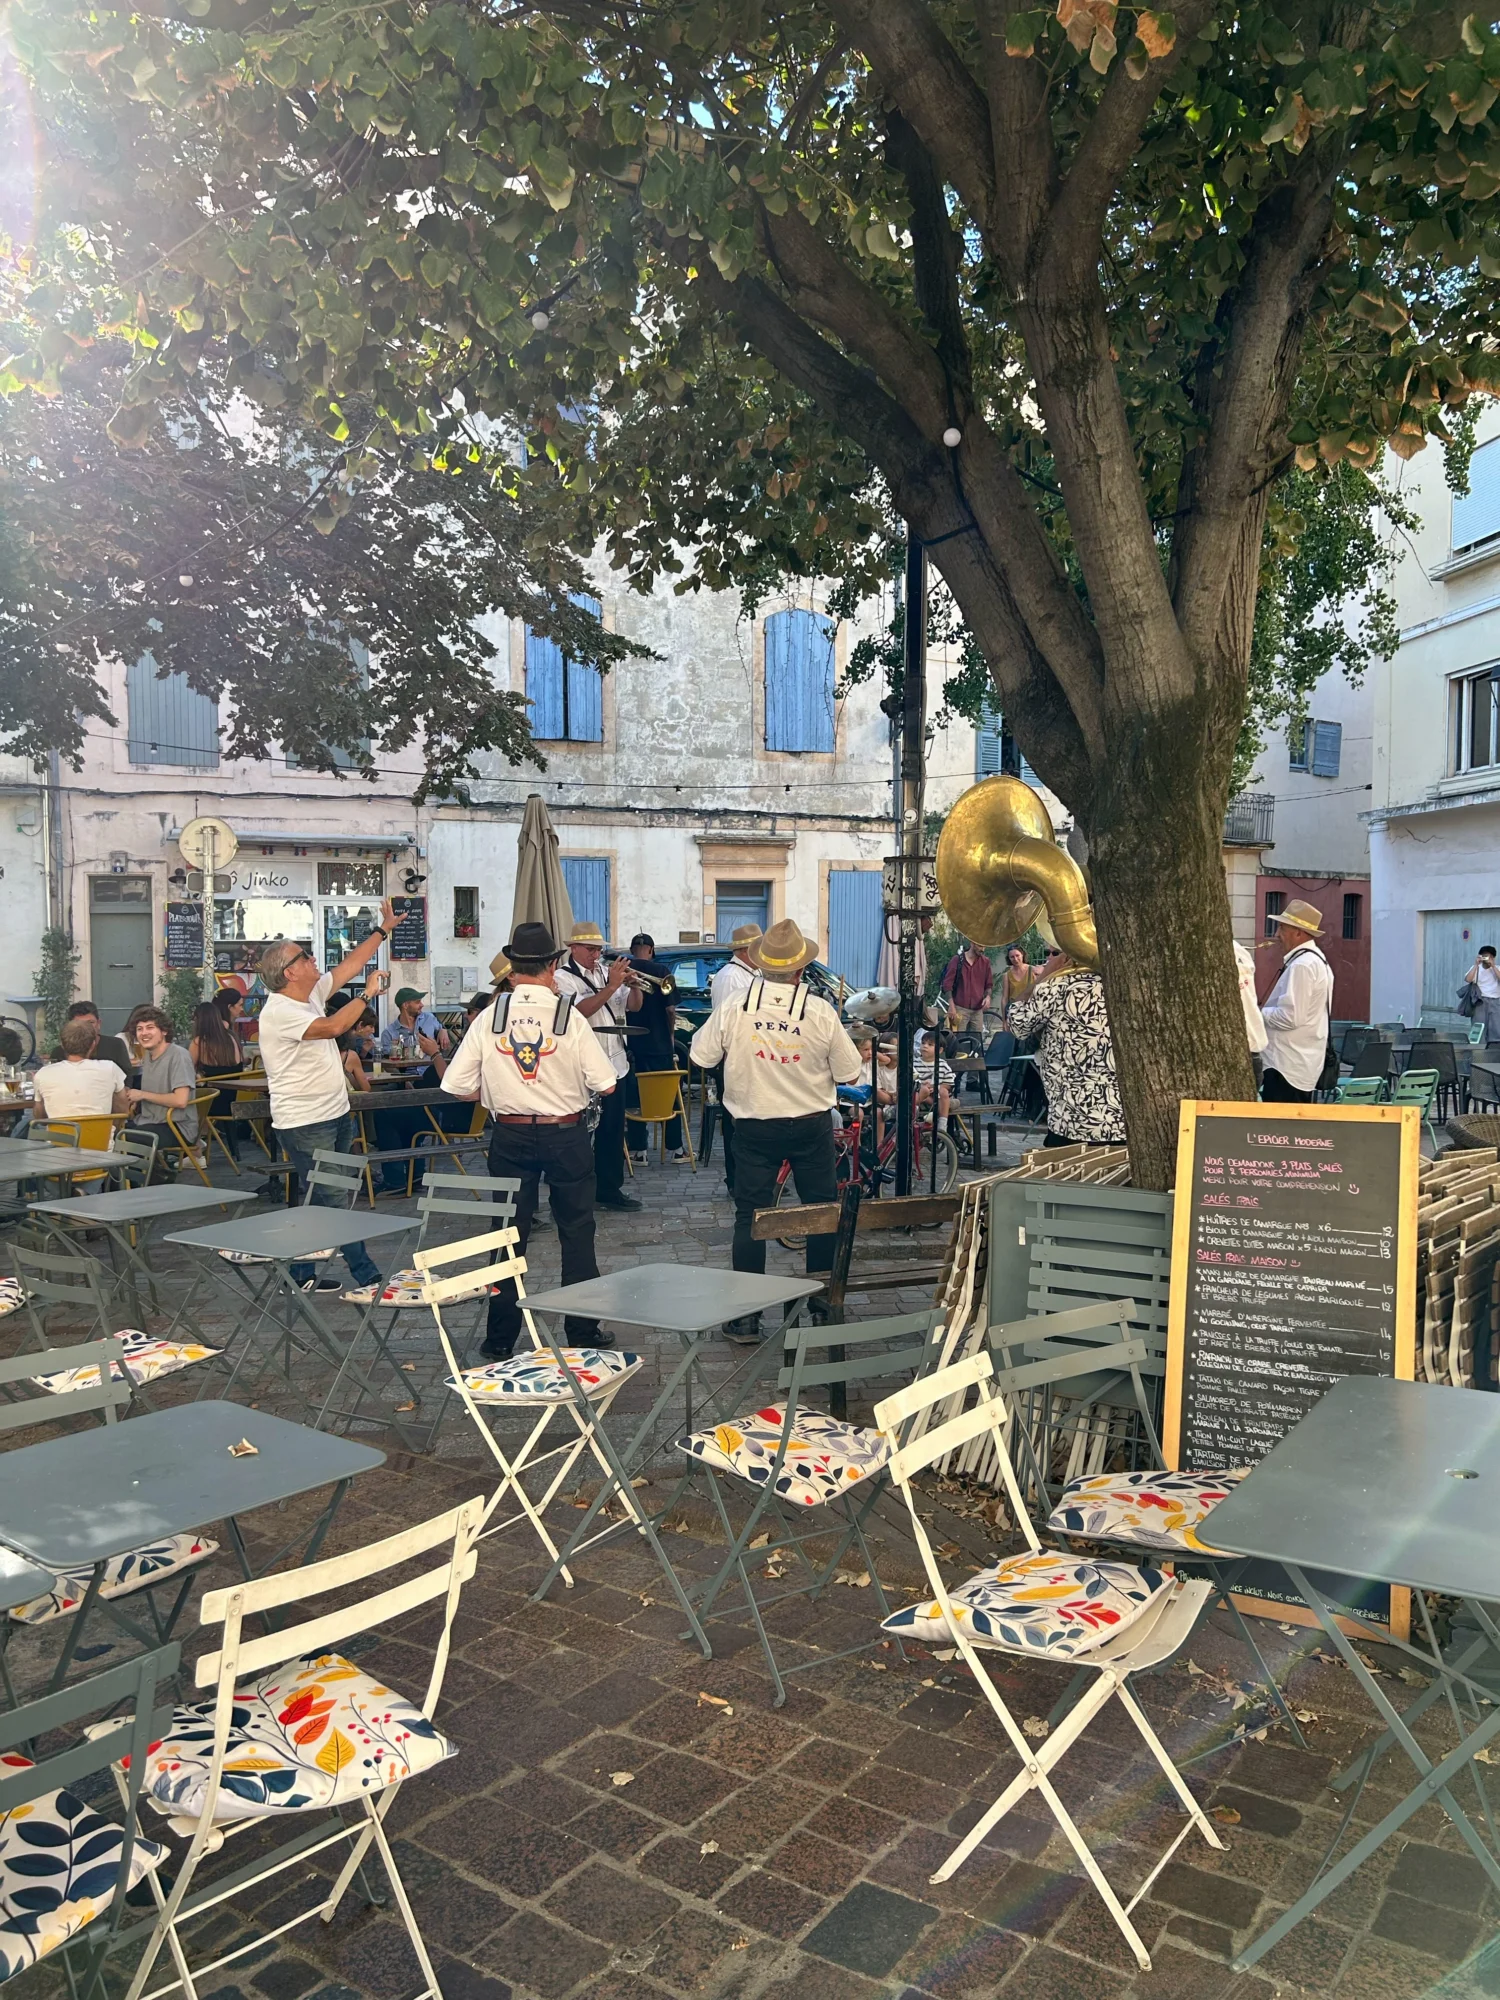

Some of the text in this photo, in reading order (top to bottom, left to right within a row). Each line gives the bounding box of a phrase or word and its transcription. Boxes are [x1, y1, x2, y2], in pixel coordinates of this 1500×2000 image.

[242, 872, 288, 890] Jinko
[511, 1016, 542, 1027] PEÑA
[754, 1020, 801, 1036] PEÑA
[755, 1050, 801, 1064] ALES
[1294, 1136, 1335, 1148] MODERNE
[1204, 1156, 1343, 1173] NOUS DEMANDONS 3 PLATS SALÉS
[1204, 1166, 1321, 1178] POUR 2 PERSONNES MINIMUM
[1202, 1176, 1225, 1184] MERCI
[1229, 1178, 1249, 1186] POUR
[1252, 1179, 1273, 1188] VOTRE
[1204, 1193, 1260, 1206] SALÉS FRAIS
[1240, 1218, 1250, 1226] DE
[1253, 1220, 1292, 1230] CAMARGUE
[1231, 1228, 1240, 1236] DE
[1242, 1228, 1284, 1239] CAMARGUE
[1327, 1236, 1357, 1245] MAISON
[1380, 1240, 1391, 1248] 10
[1267, 1242, 1294, 1251] MAISON
[1340, 1248, 1367, 1256] MAISON
[1380, 1248, 1392, 1259] 13
[1196, 1249, 1287, 1266] SALÉS FRAIS MAISON
[1250, 1272, 1260, 1280] DE
[1260, 1273, 1300, 1282] CAMARGUE
[1302, 1276, 1334, 1286] TAUREAU
[1382, 1284, 1394, 1294] 15
[1284, 1282, 1294, 1290] DE
[1201, 1292, 1208, 1300] ET
[1213, 1293, 1238, 1302] BREBIS
[1242, 1288, 1252, 1297] DE
[1318, 1296, 1364, 1308] BARIGOULE
[1382, 1302, 1392, 1312] 12
[1198, 1316, 1208, 1324] AU
[1201, 1308, 1232, 1318] MARBRÉ
[1380, 1328, 1392, 1340] 14
[1199, 1330, 1231, 1340] PANISSES
[1246, 1336, 1254, 1344] LA
[1284, 1340, 1304, 1348] COULIS
[1316, 1344, 1344, 1354] TOMATE
[1379, 1348, 1391, 1360] 15
[1199, 1338, 1208, 1346] ET
[1232, 1342, 1242, 1350] DE
[1244, 1344, 1272, 1354] BREBIS
[1281, 1348, 1289, 1356] LA
[1232, 1364, 1242, 1372] DE
[1234, 1358, 1244, 1366] DE
[1248, 1360, 1271, 1368] CRABE
[1198, 1374, 1221, 1384] TATAKI
[1238, 1380, 1268, 1390] CANARD
[1273, 1384, 1295, 1394] FAÇON
[1298, 1387, 1320, 1396] TIGRE
[1240, 1400, 1251, 1408] DE
[1234, 1408, 1268, 1416] BURRATA
[1230, 1417, 1239, 1425] DE
[1194, 1430, 1212, 1440] THON
[1244, 1426, 1284, 1438] JAPONAISE
[1193, 1448, 1226, 1462] TARTARE
[1230, 1456, 1240, 1464] DE
